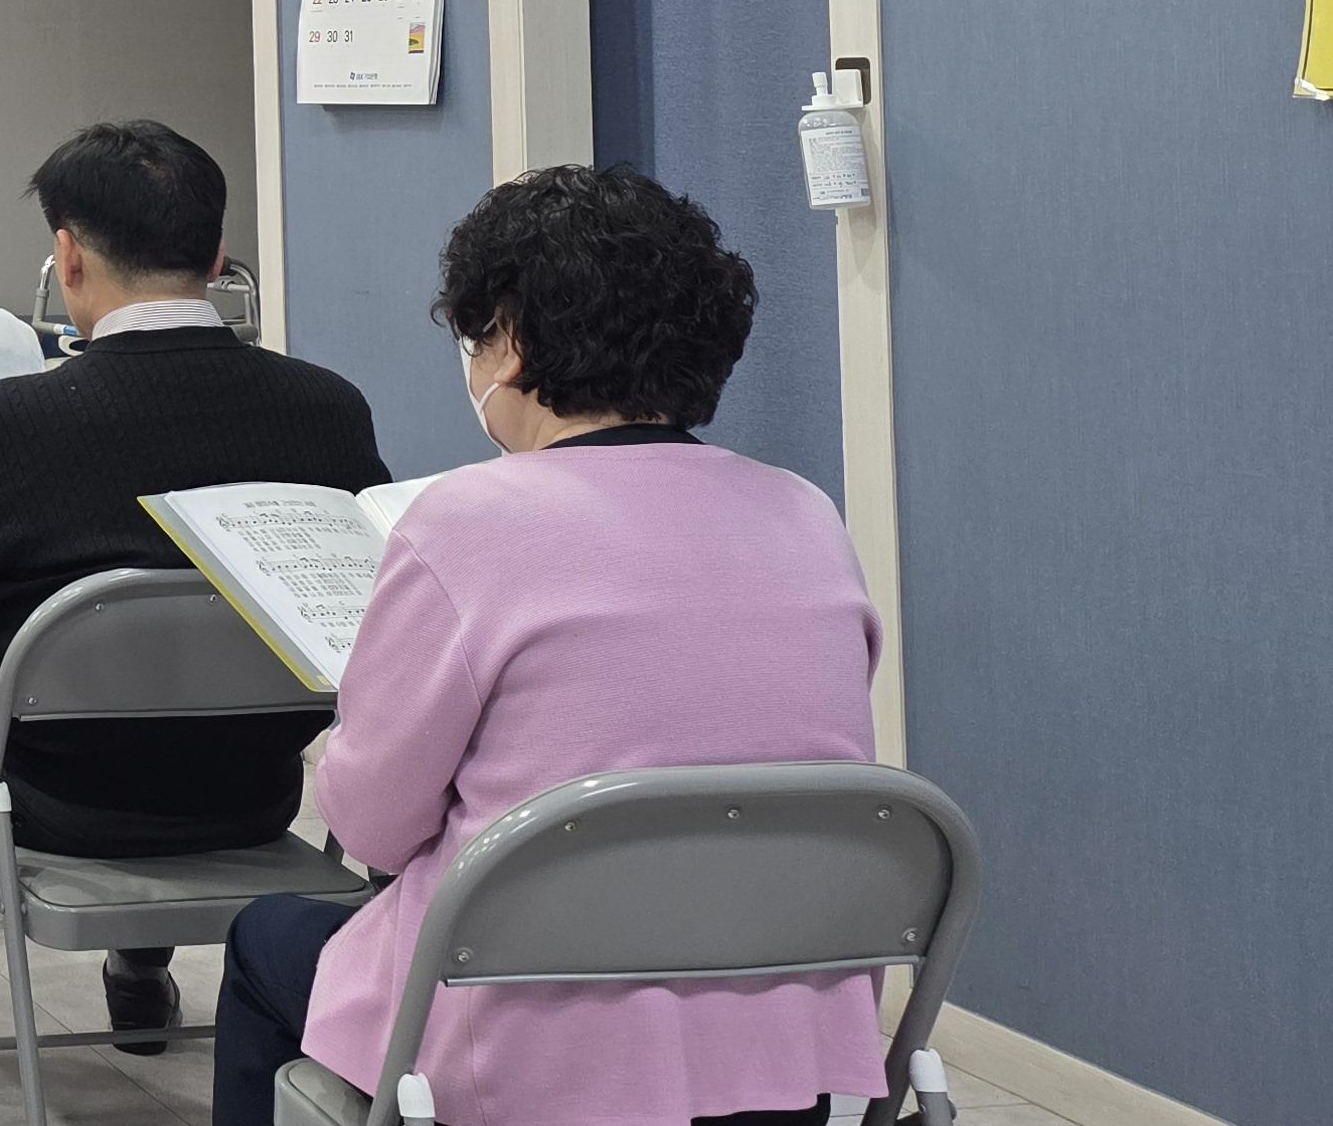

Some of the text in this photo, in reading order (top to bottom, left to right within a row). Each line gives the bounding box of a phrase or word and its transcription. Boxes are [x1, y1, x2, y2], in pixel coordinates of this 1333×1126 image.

[309, 30, 353, 43] 29 30 31
